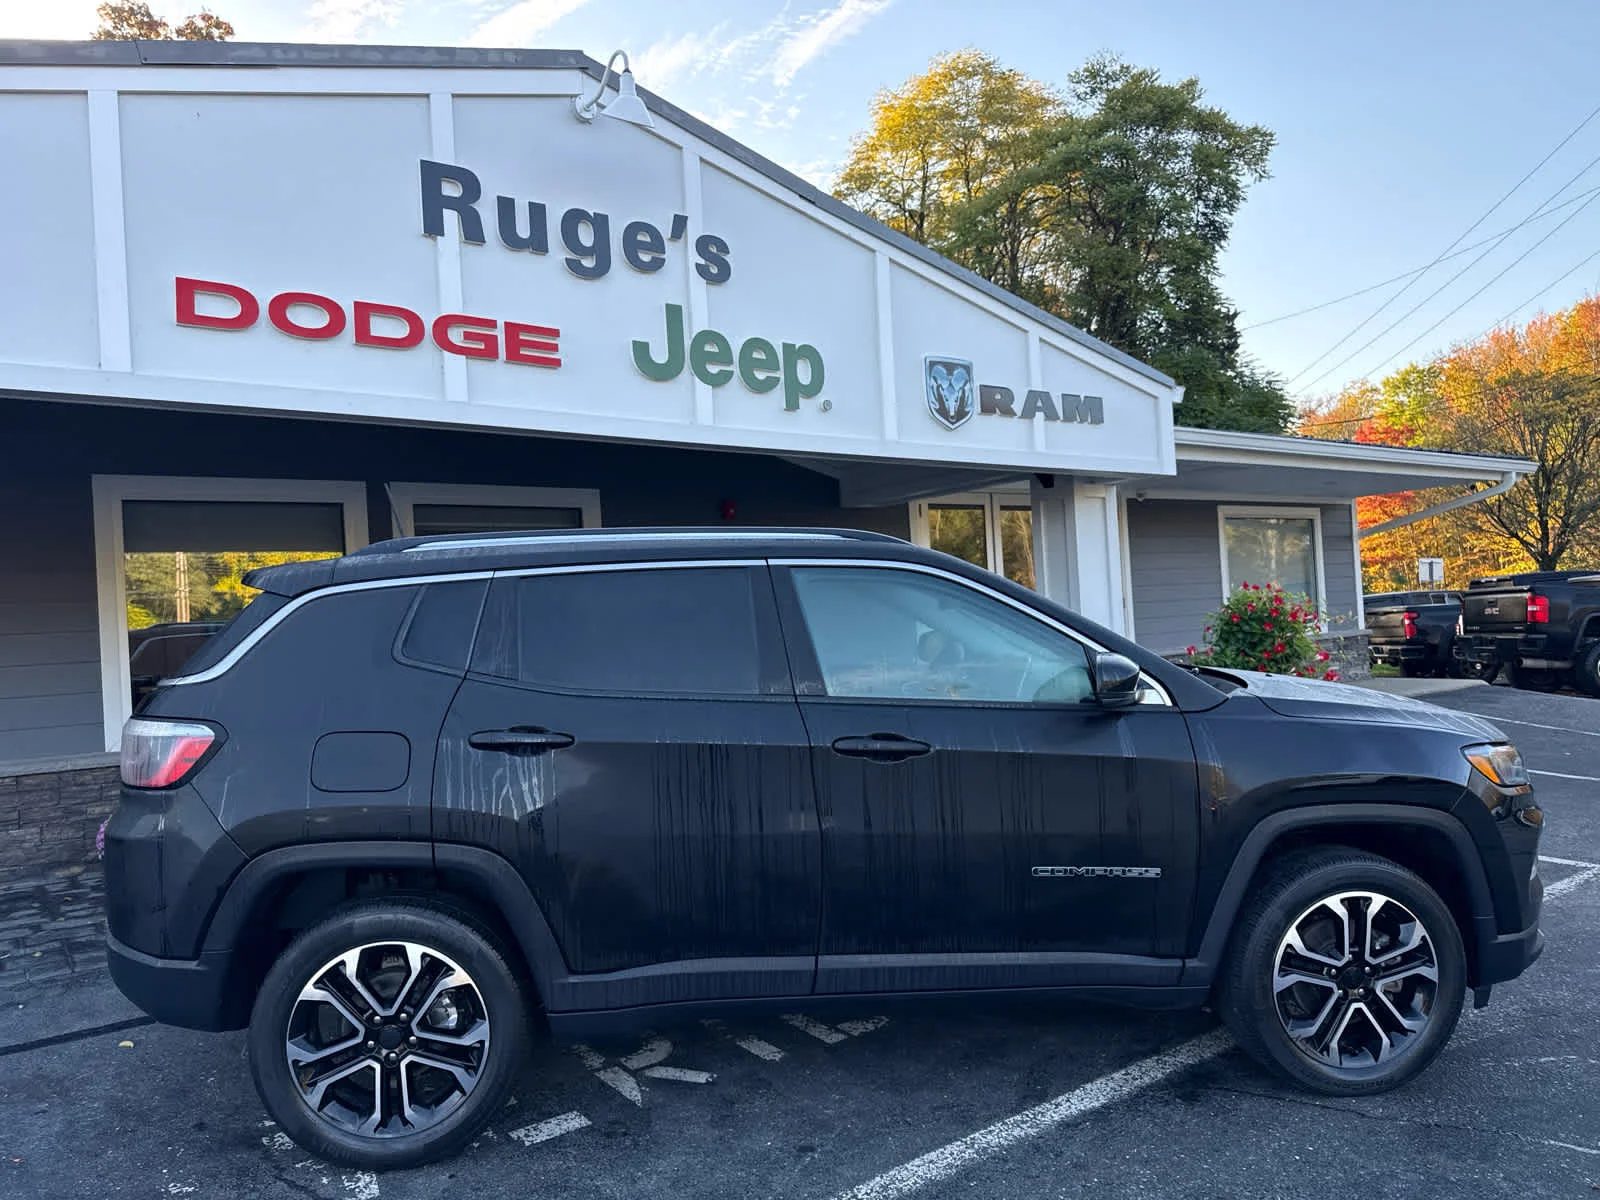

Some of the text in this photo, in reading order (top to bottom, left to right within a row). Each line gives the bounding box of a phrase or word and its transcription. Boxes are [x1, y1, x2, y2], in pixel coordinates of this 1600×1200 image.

[419, 159, 732, 284] Ruge's
[175, 276, 562, 368] DODGE
[978, 384, 1104, 425] RAM
[1031, 866, 1162, 878] COMPASS
